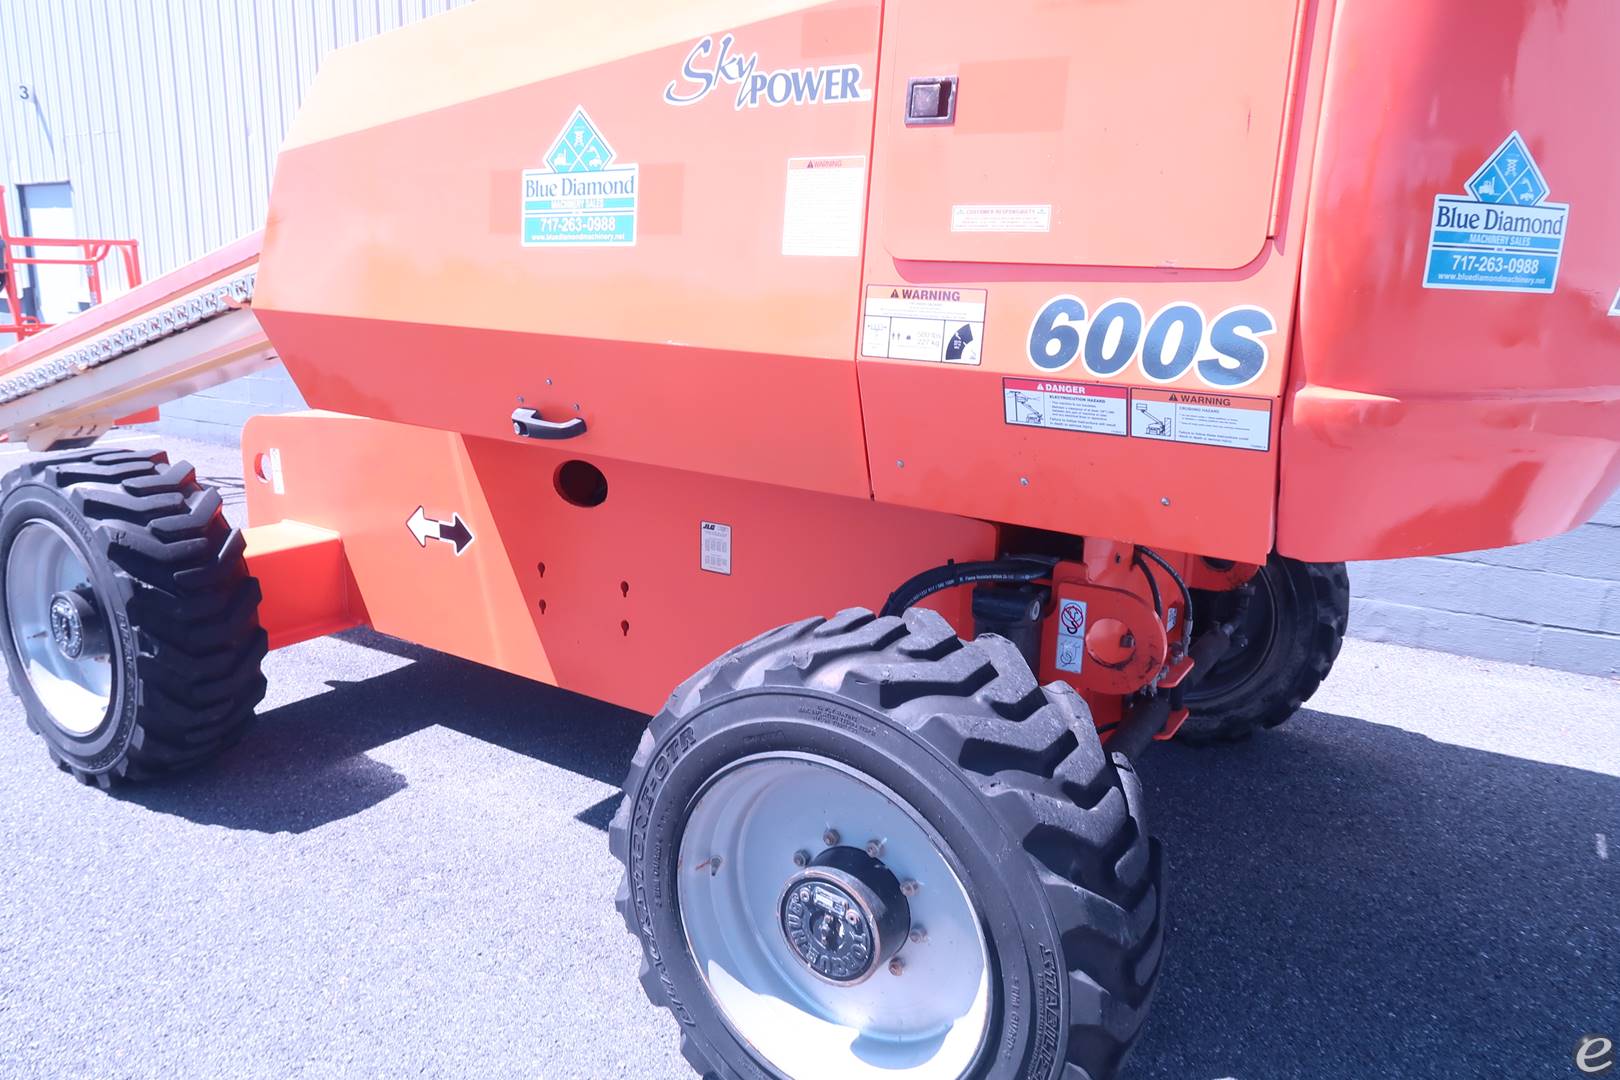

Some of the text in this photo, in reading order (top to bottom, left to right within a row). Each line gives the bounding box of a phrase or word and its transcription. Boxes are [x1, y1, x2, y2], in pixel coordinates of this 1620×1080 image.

[666, 37, 860, 107] Sky POWER
[19, 85, 29, 99] 3
[526, 174, 635, 197] Blue Diamond
[541, 216, 616, 232] 717-263-0988
[1435, 205, 1564, 235] Blue Diamond
[1469, 234, 1531, 246] MACHINERY SALES
[1452, 255, 1539, 274] 717-263-0988
[902, 289, 960, 301] WARNING
[1030, 298, 1273, 386] 600S
[1046, 384, 1086, 394] DANGER
[1180, 394, 1231, 406] WARNING
